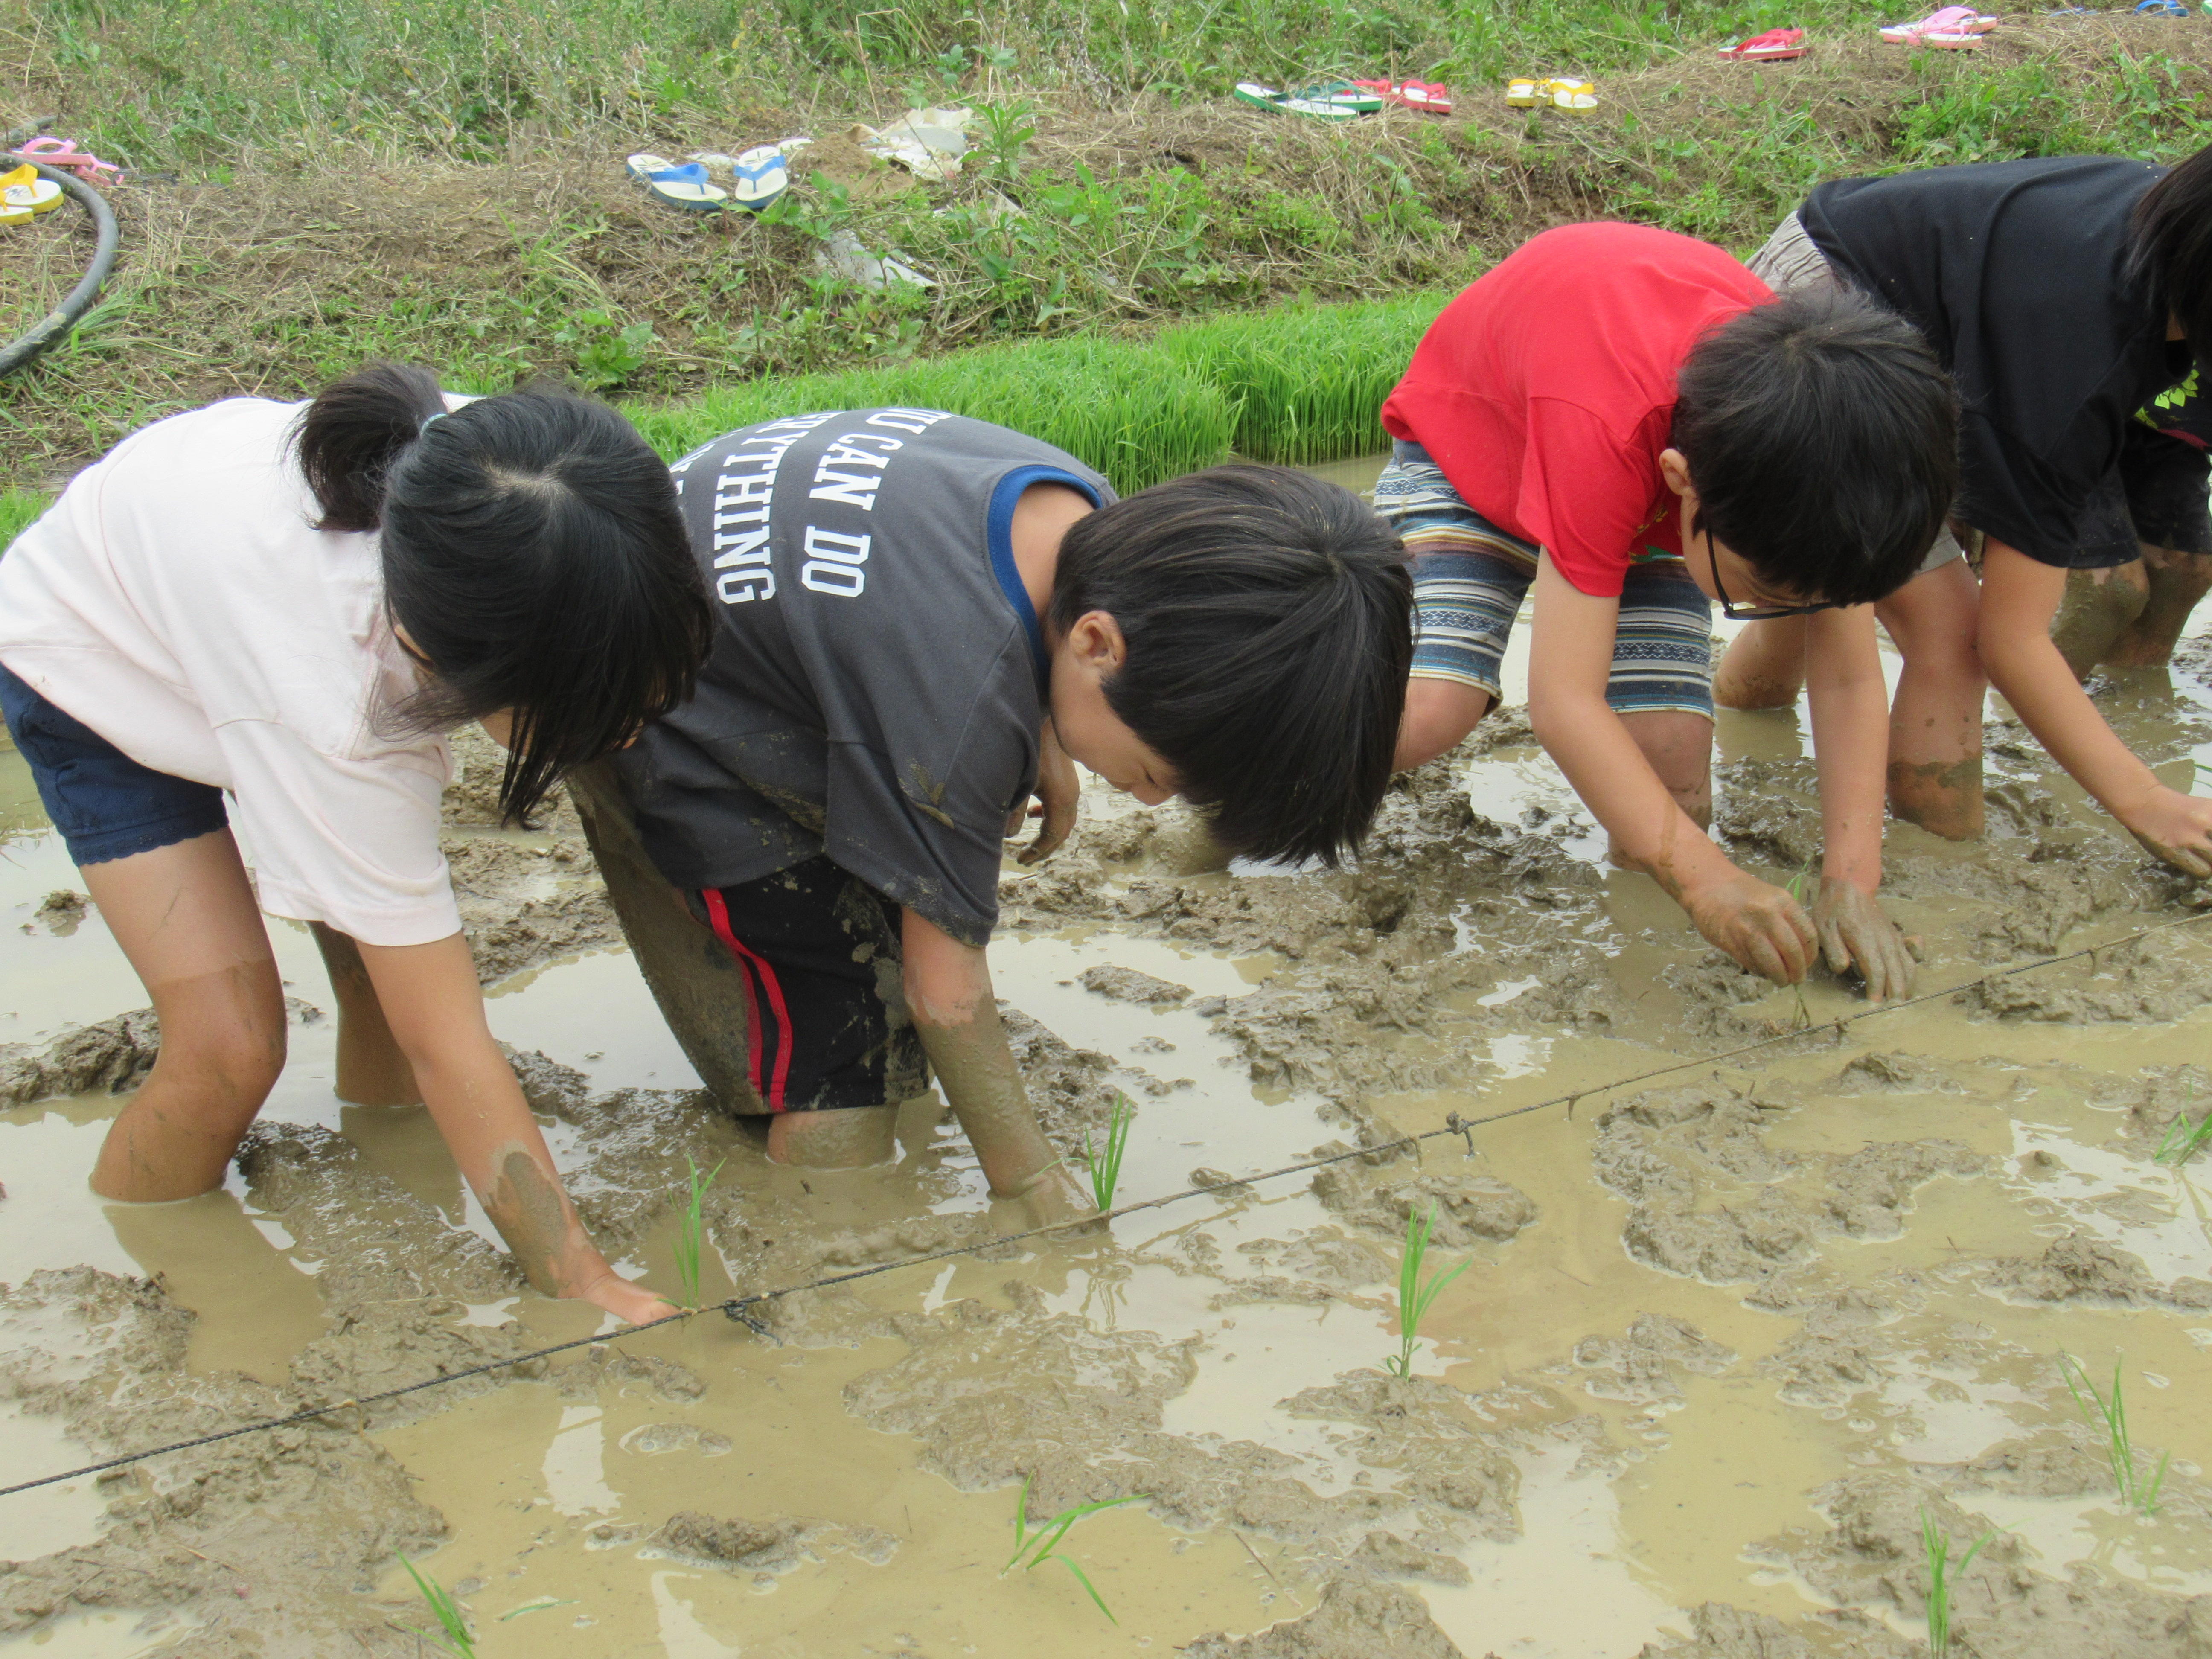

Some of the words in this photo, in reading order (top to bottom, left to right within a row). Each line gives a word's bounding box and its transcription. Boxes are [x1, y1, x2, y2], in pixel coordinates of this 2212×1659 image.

[866, 408, 960, 434] OU
[809, 433, 904, 511] CAN
[801, 525, 871, 598] DO
